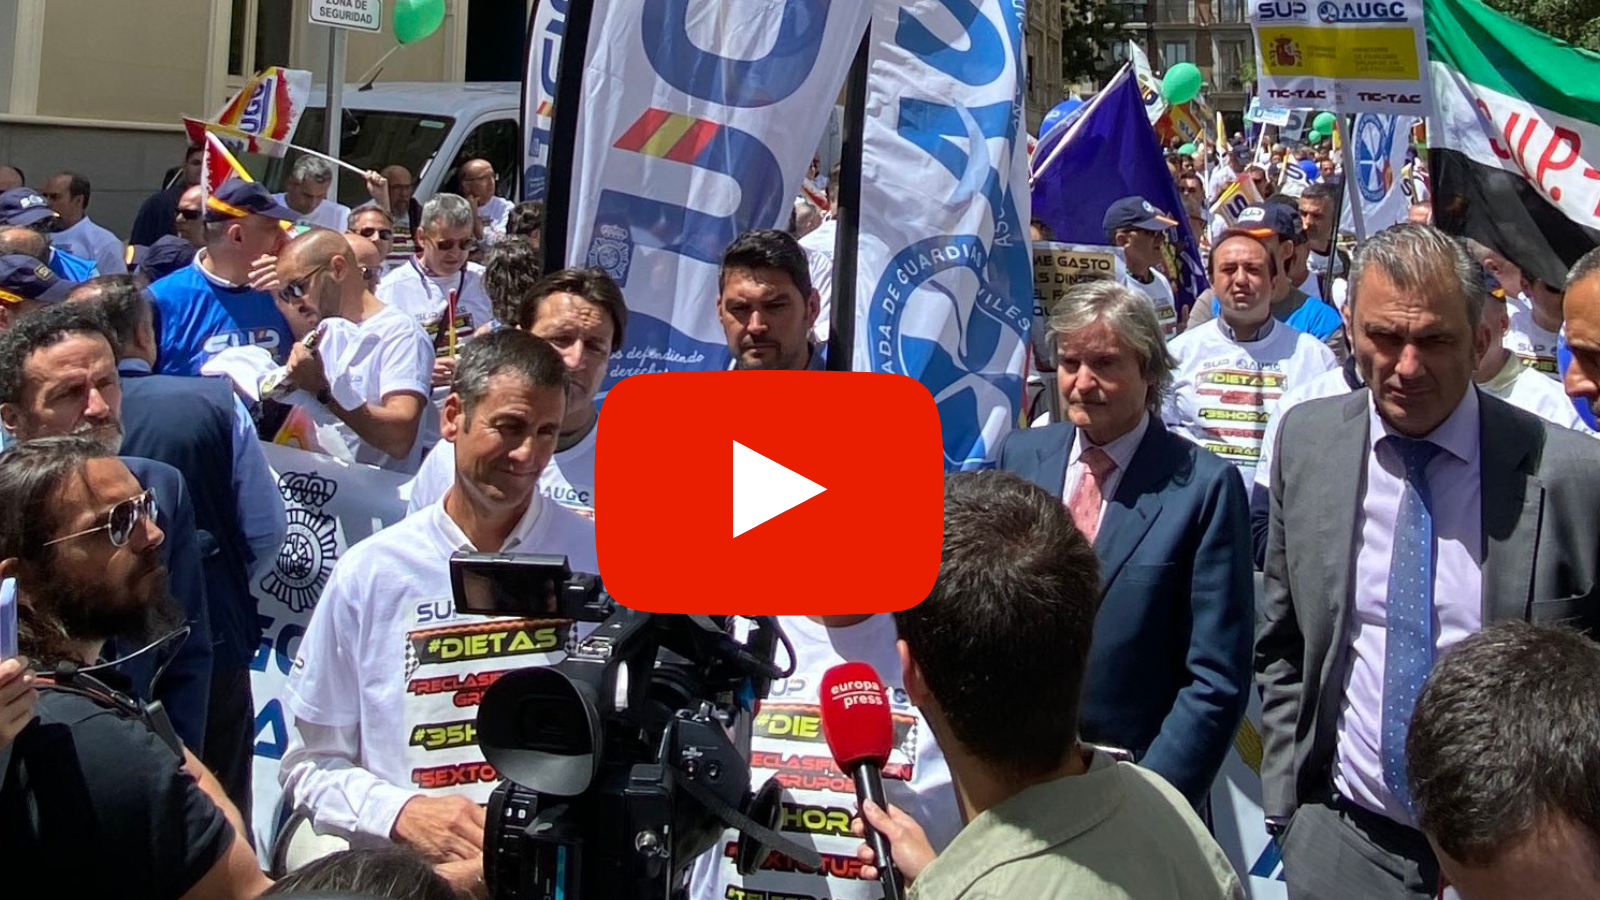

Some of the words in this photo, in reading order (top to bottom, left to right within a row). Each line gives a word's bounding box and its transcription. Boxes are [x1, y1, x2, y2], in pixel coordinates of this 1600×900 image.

[355, 0, 368, 10] DE
[1258, 2, 1307, 19] SUP
[1342, 2, 1406, 18] AUGC
[319, 6, 373, 24] SEGURIDAD
[1267, 89, 1327, 99] TIC-TAC
[1357, 92, 1422, 104] TIC-TAC
[1057, 256, 1111, 271] GASTO
[882, 283, 901, 315] DE
[896, 242, 982, 285] GUARDIAS
[626, 345, 705, 368] defendiendo
[1203, 359, 1230, 370] SUP
[544, 485, 590, 503] AUGC
[417, 600, 457, 623] SU
[427, 627, 558, 660] #DIETAS
[769, 678, 807, 697] UP
[831, 680, 880, 695] europa
[454, 691, 484, 706] GR
[844, 694, 883, 709] press
[756, 714, 820, 738] #DIE
